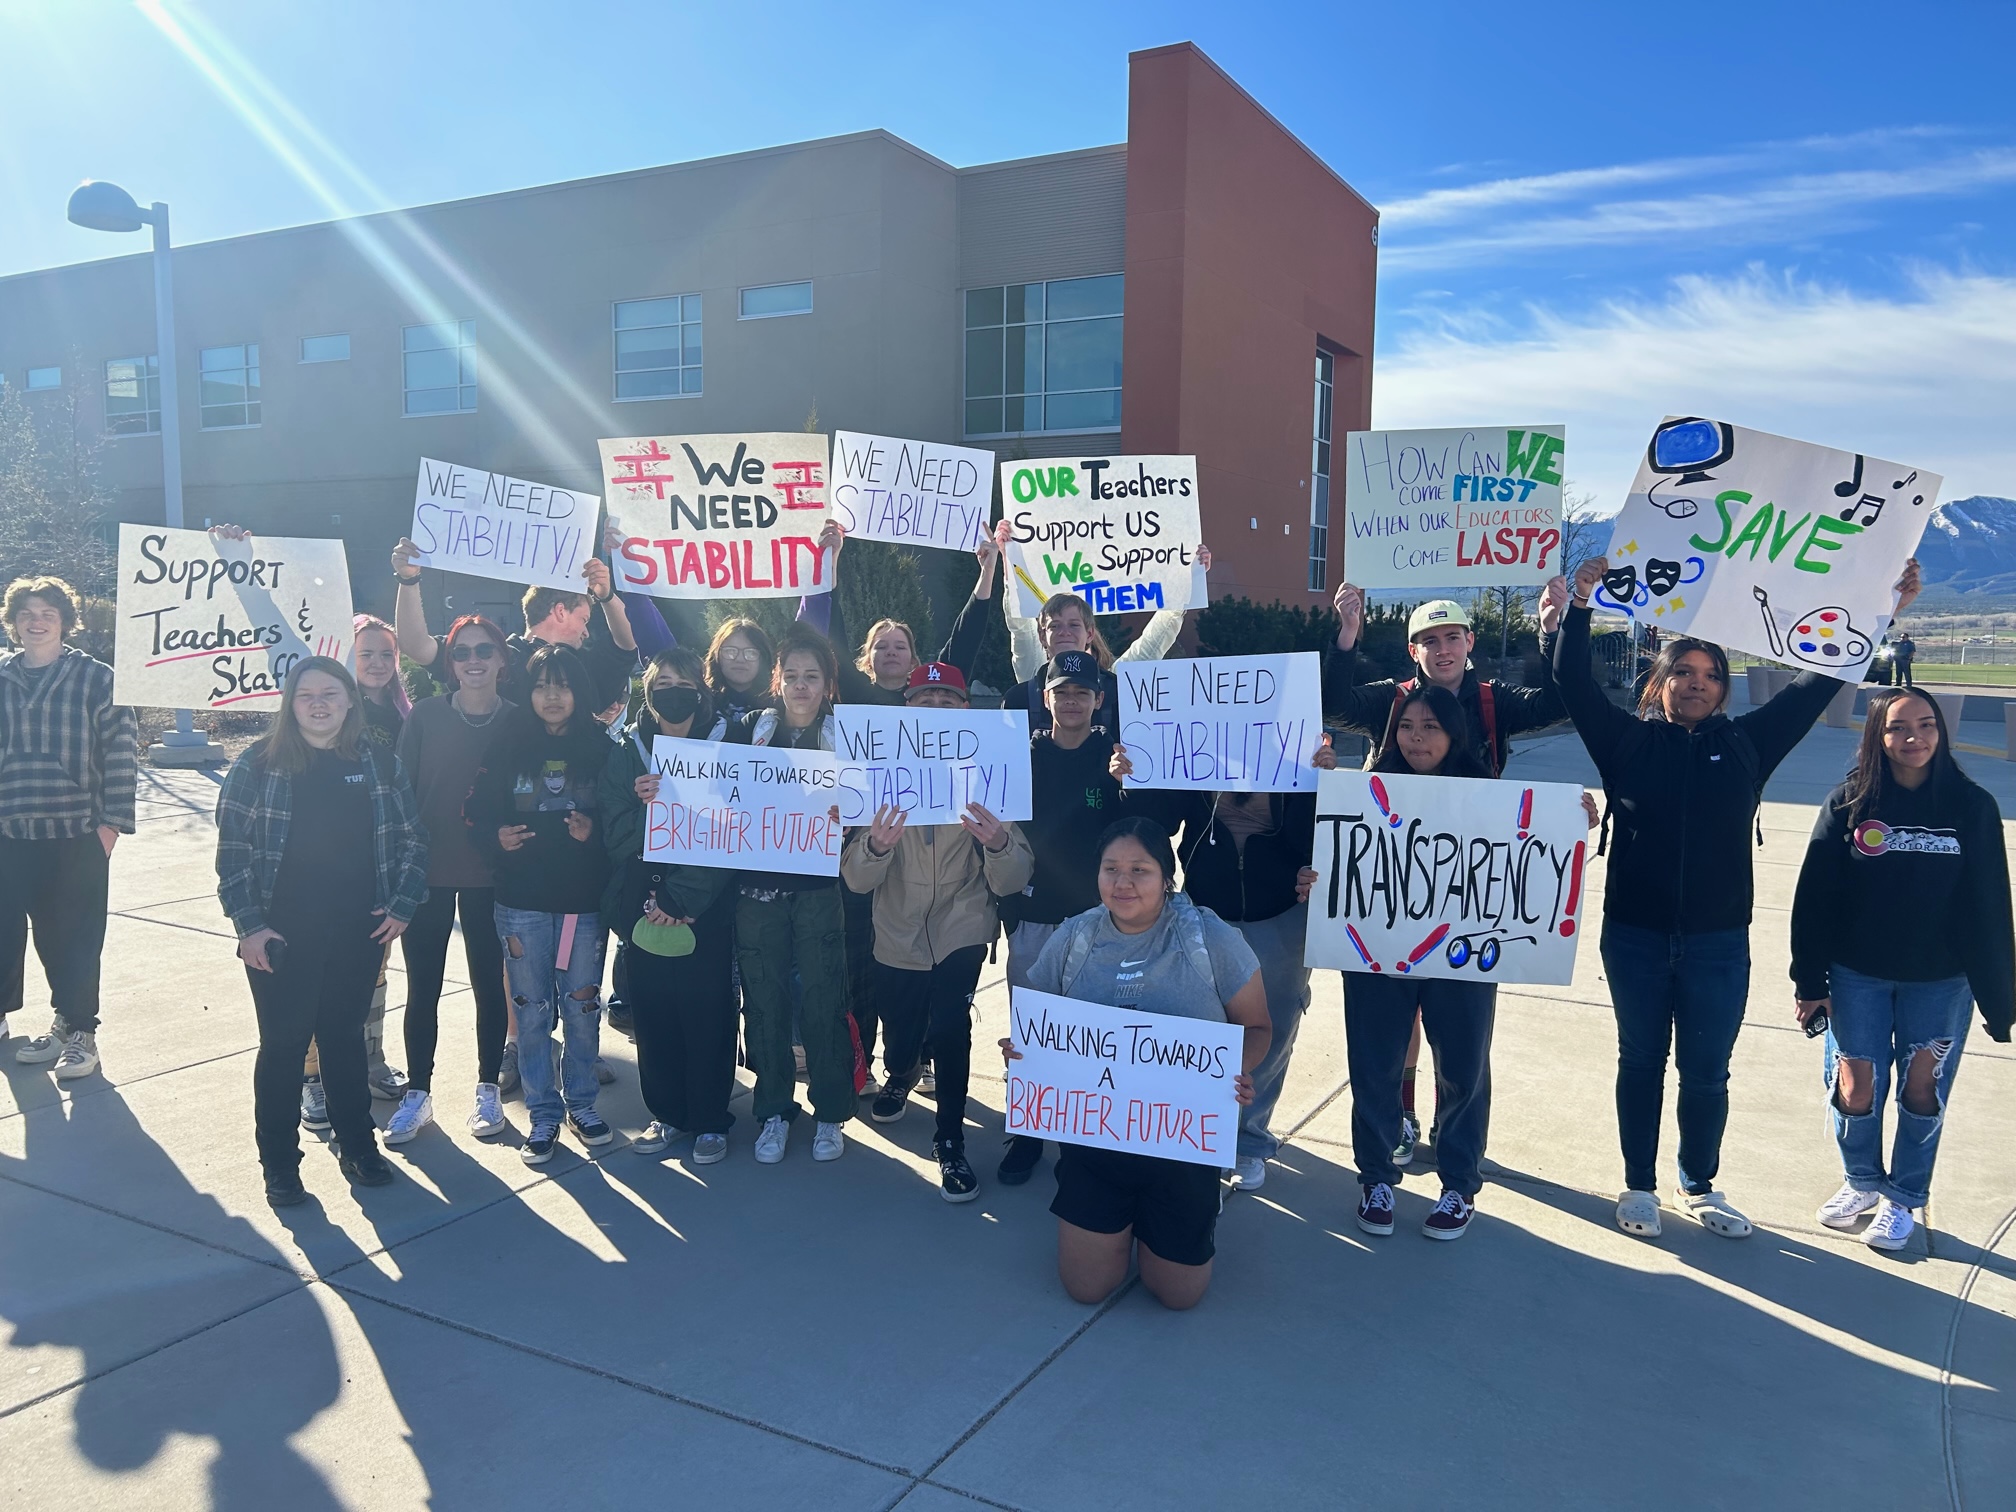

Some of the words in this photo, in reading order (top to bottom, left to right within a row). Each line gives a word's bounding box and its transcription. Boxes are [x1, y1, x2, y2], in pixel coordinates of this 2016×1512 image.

[680, 441, 765, 487] We
[840, 438, 885, 482] WE
[894, 443, 978, 497] NEED
[1011, 466, 1080, 503] OUR
[1080, 460, 1191, 500] Teachers
[1359, 433, 1449, 493] HOW
[1458, 431, 1500, 476] CAN
[1506, 430, 1565, 486] WE
[426, 461, 467, 499] WE
[483, 472, 575, 519] NEED
[1453, 474, 1538, 503] FIRST
[671, 494, 778, 531] NEED
[835, 484, 983, 551] STABILITY!
[1011, 512, 1114, 551] Support
[1125, 511, 1161, 537] US
[1351, 509, 1409, 538] WHEN
[1420, 511, 1453, 533] OUR
[1455, 504, 1554, 529] EDUCATORS
[1688, 490, 1864, 574] SAVE
[416, 503, 581, 578] STABILITY!
[621, 537, 827, 590] STABILITY
[1042, 551, 1094, 585] We
[1097, 542, 1191, 576] Support
[1393, 544, 1450, 570] COME
[1456, 528, 1560, 570] LAST?
[1072, 580, 1165, 612] THEM
[130, 606, 282, 655] Teachers
[298, 597, 313, 641] &
[927, 664, 940, 681] LA
[1125, 667, 1171, 713] WE
[1191, 662, 1276, 706] NEED
[838, 719, 887, 761] WE
[896, 719, 980, 761] NEED
[1121, 719, 1305, 787] STABILITY!
[654, 753, 740, 781] WALKING
[748, 760, 836, 789] TOWARDS
[838, 764, 1007, 819] STABILITY!
[729, 786, 741, 803] A
[649, 801, 753, 855] BRIGHTER
[762, 806, 837, 856] FUTURE
[1889, 842, 1960, 854] COLORADO
[1316, 812, 1585, 937] TRANSPARENCY!
[1114, 983, 1145, 999] NIKE
[1015, 1007, 1117, 1061] WALKING
[1123, 1025, 1228, 1079] TOWARDS
[1098, 1067, 1115, 1089] A
[1009, 1077, 1120, 1141] BRIGHTER
[1126, 1100, 1218, 1153] FUTURE
